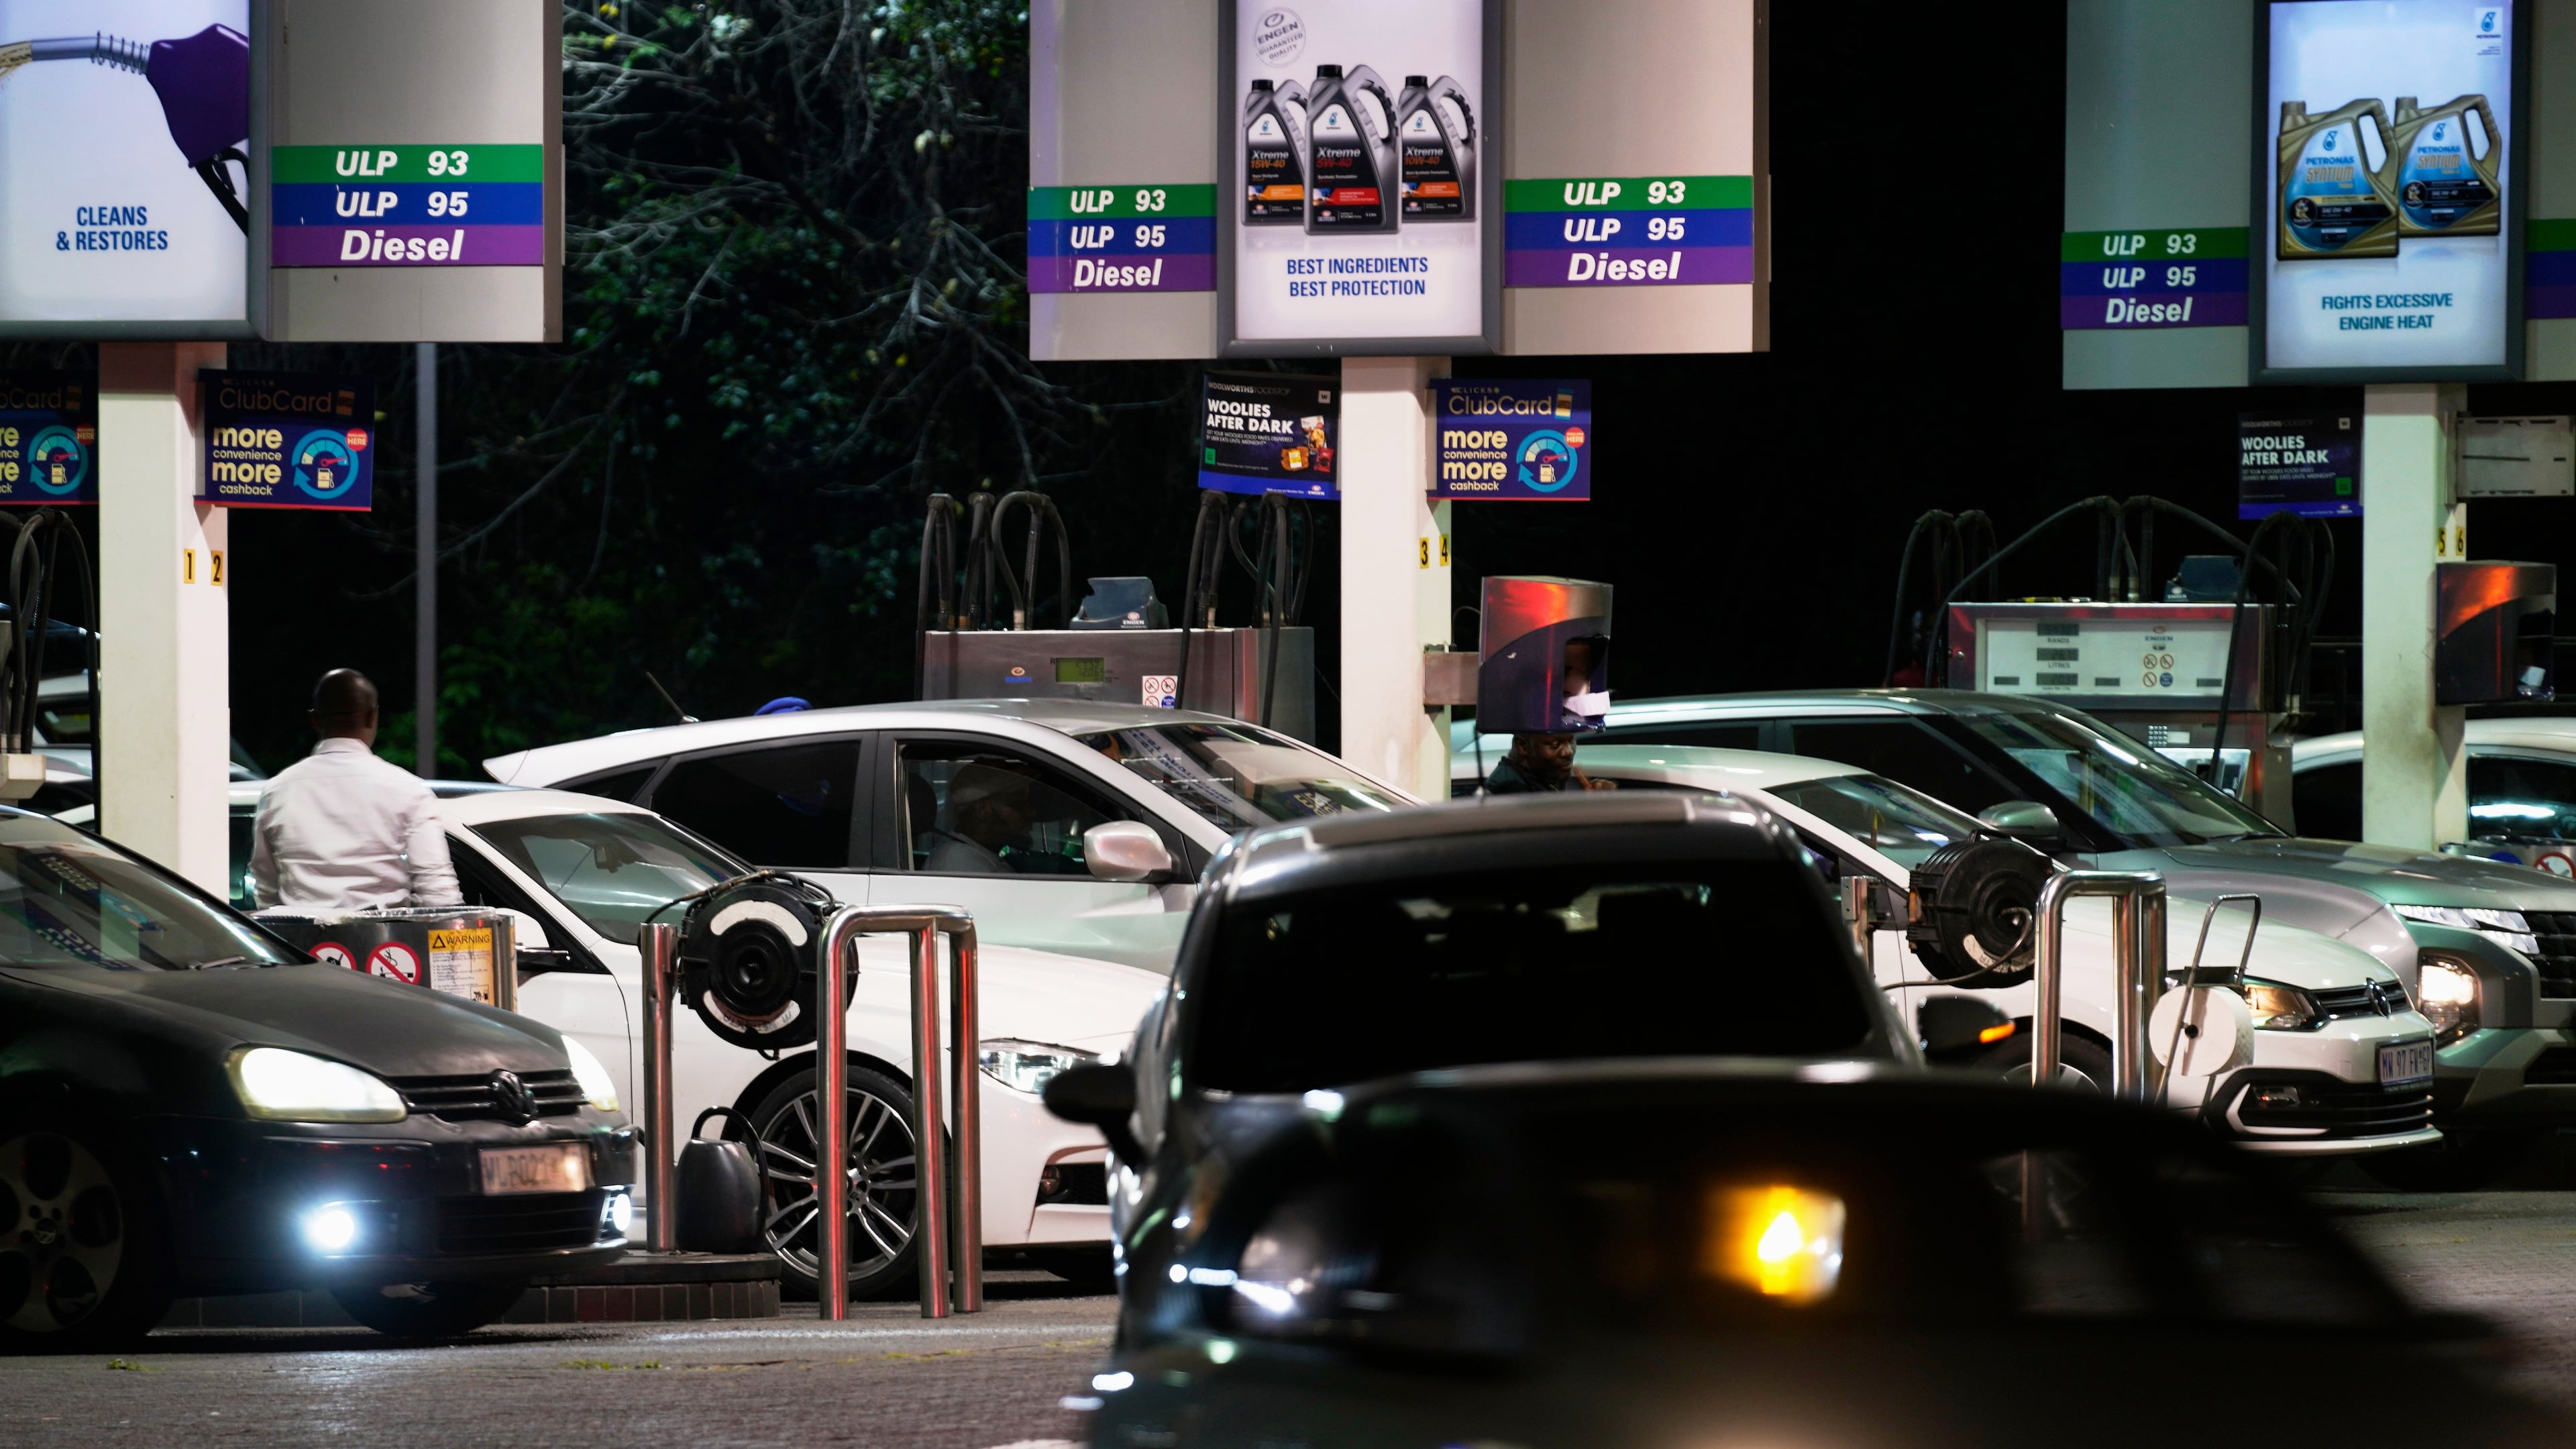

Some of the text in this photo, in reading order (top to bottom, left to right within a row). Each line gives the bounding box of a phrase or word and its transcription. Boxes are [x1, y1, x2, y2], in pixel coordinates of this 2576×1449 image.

[1257, 21, 1299, 44] ENGEN
[1259, 33, 1303, 55] GUARANTEED
[1269, 44, 1297, 59] QUALITY
[1252, 150, 1289, 160] Xtreme
[1316, 147, 1361, 158] Xtreme
[1405, 147, 1444, 156] Xtreme
[2306, 156, 2355, 164] PETRONAS
[336, 150, 469, 176] ULP 93
[1250, 159, 1286, 168] 15W-40
[1316, 158, 1353, 168] 5W-40
[1070, 189, 1167, 213] ULP 93
[1564, 180, 1686, 205] ULP 93
[336, 191, 469, 217] ULP 95
[76, 206, 148, 226] CLEANS
[1070, 225, 1166, 249] ULP 95
[1564, 217, 1686, 241] ULP 95
[56, 231, 168, 251] & RESTORES
[340, 229, 465, 261] Diesel
[2103, 233, 2197, 256] ULP 93
[1073, 258, 1163, 287] Diesel
[1287, 258, 1428, 274] BEST INGREDIENTS
[1567, 251, 1682, 281] Diesel
[2103, 266, 2197, 288] ULP 95
[1289, 280, 1426, 297] BEST PROTECTION
[2105, 297, 2193, 323] Diesel
[2321, 293, 2453, 310] FIGHTS EXCESSIVE
[2339, 315, 2434, 330] ENGINE HEAT
[219, 387, 332, 413] ClubCard
[1207, 398, 1271, 417] WOOLIES
[1448, 395, 1552, 415] ClubCard
[1205, 413, 1294, 434] AFTER DARK
[76, 431, 95, 440] HERE
[213, 427, 283, 449] more
[347, 437, 366, 446] HERE
[1443, 430, 1508, 449] more
[2241, 435, 2305, 450] WOOLIES
[213, 449, 282, 461] convenience
[1444, 449, 1508, 460] convenience
[2241, 449, 2329, 466] AFTER DARK
[212, 462, 282, 484] more
[1443, 461, 1507, 480] more
[219, 484, 273, 495] cashback
[1450, 480, 1499, 491] cashback
[1442, 537, 1448, 563] 4
[2440, 530, 2445, 553] 5
[2458, 529, 2464, 553] 6
[1421, 540, 1428, 566] 3
[187, 552, 192, 580] 1
[213, 554, 221, 582] 2
[445, 934, 490, 946] WARNING
[2398, 1049, 2406, 1076] 97
[2422, 1045, 2431, 1072] GP
